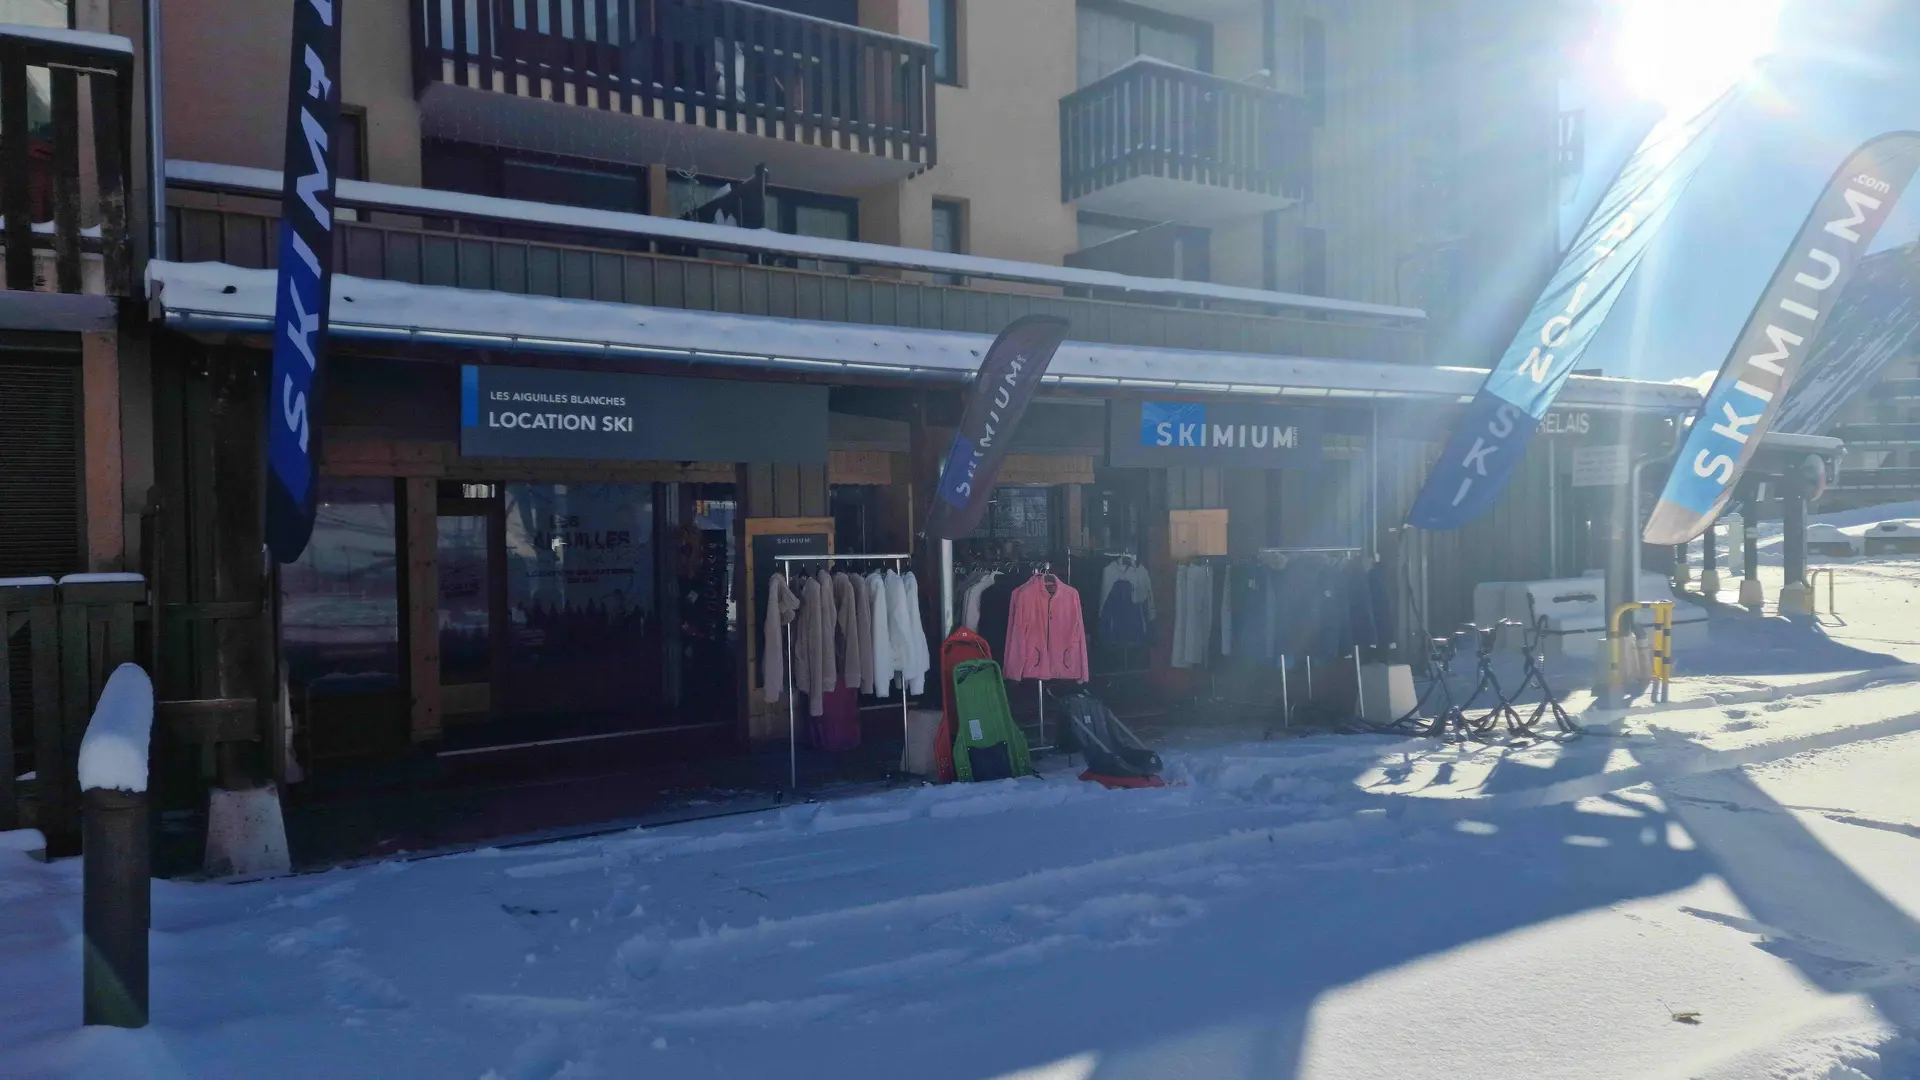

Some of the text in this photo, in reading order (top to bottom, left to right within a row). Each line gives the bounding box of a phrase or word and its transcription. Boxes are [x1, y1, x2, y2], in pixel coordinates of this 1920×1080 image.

[1694, 172, 1891, 486] SKIMIUM .com
[490, 391, 626, 406] LES AIGUILLES BLANCHES
[489, 411, 634, 432] LOCATION SKI
[1156, 422, 1293, 448] SKIMIUM
